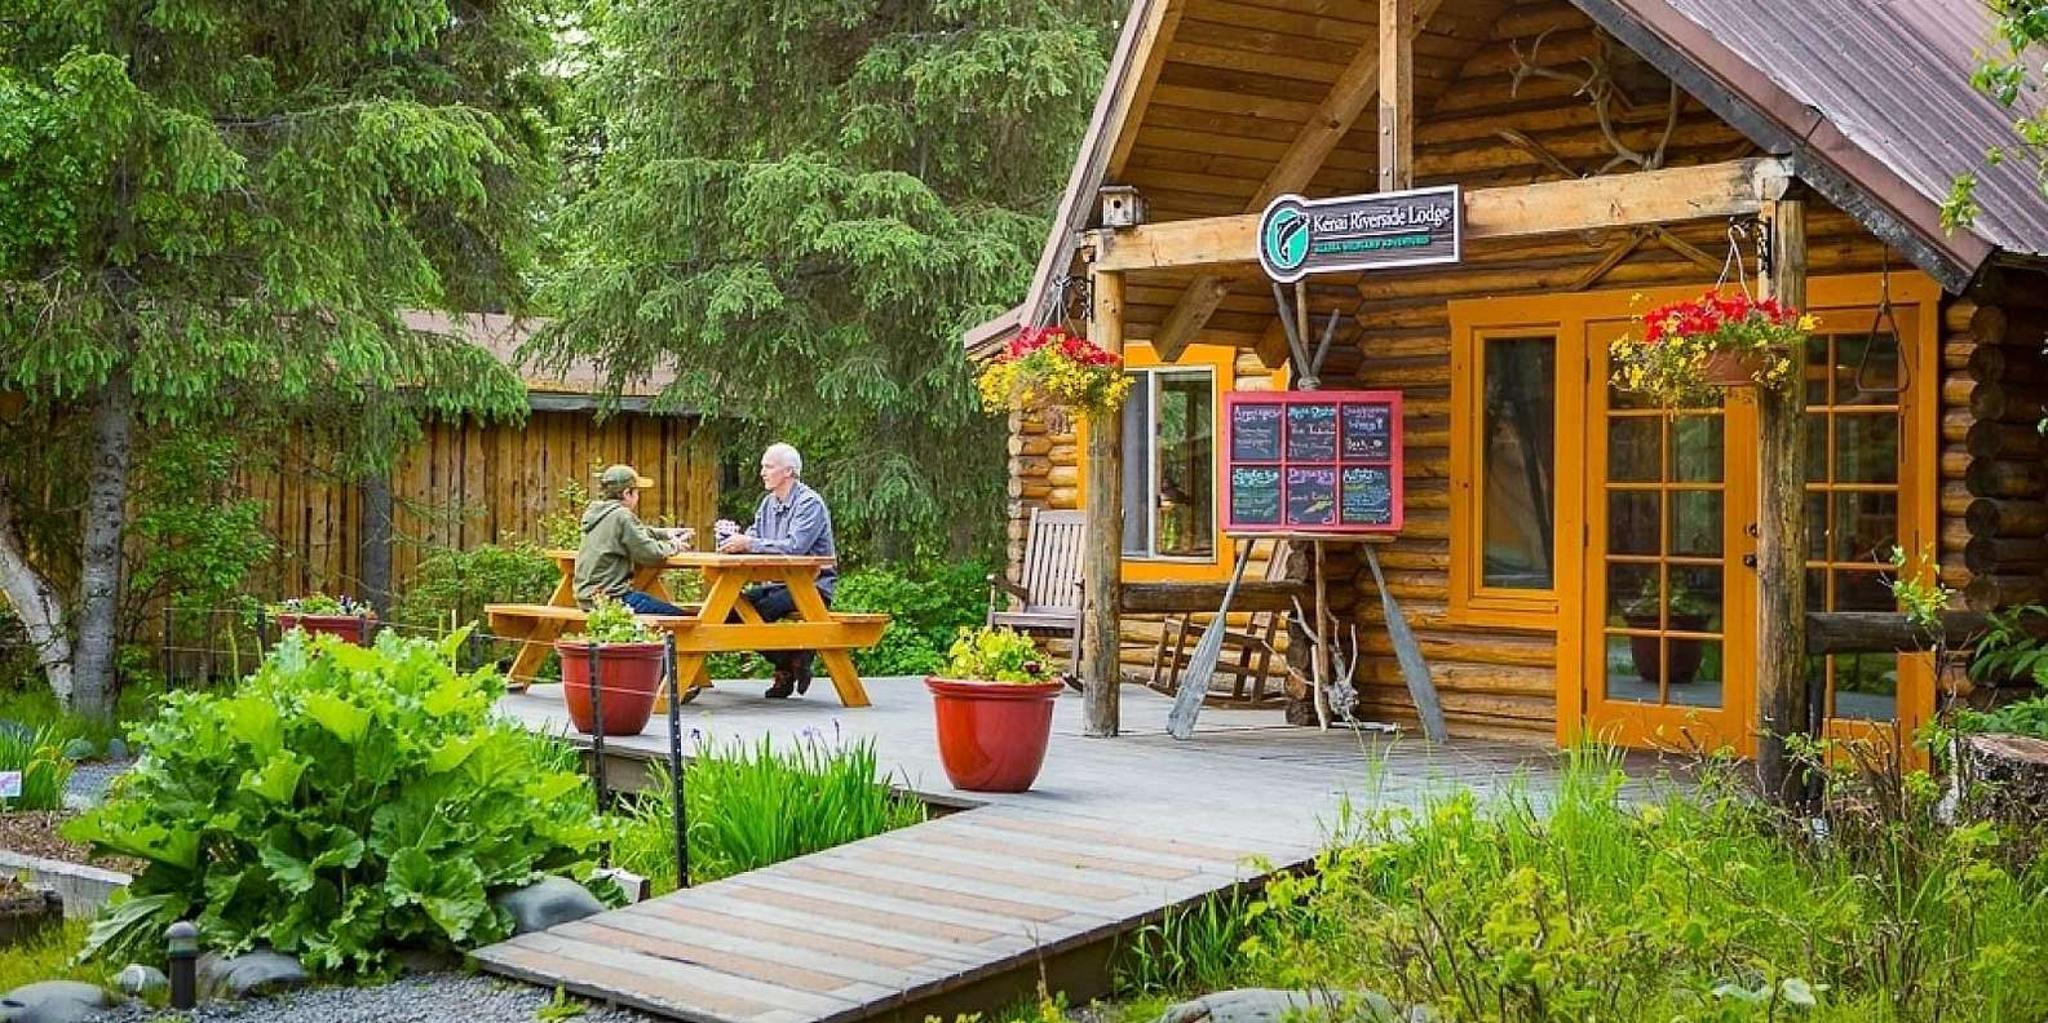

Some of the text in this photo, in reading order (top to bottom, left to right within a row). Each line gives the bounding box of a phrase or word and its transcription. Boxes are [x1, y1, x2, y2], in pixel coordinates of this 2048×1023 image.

[1313, 203, 1450, 232] Kenai Riverside Lodge
